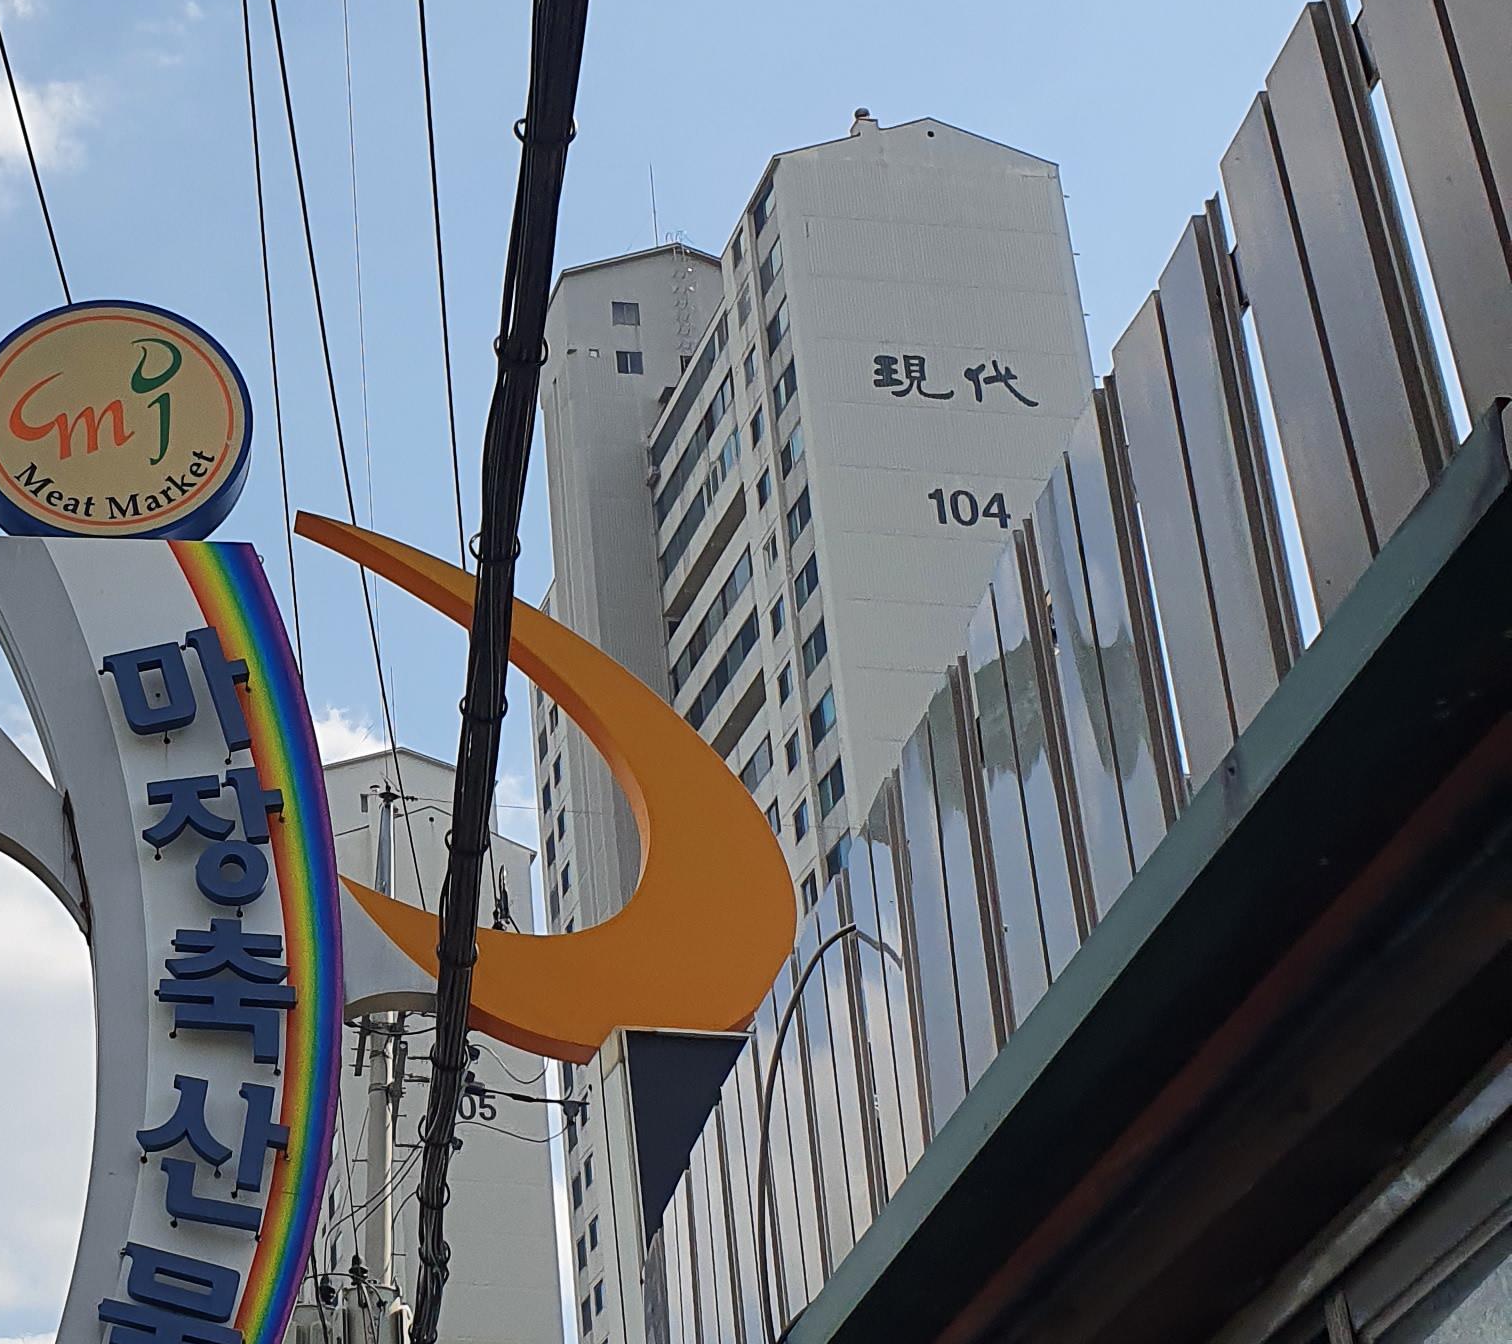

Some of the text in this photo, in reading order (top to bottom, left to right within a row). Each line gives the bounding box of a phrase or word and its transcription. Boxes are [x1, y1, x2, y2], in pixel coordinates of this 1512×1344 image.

[873, 354, 1040, 408] 現代
[13, 449, 215, 520] Meat Market
[927, 487, 1012, 529] 104
[457, 1094, 497, 1122] 05
